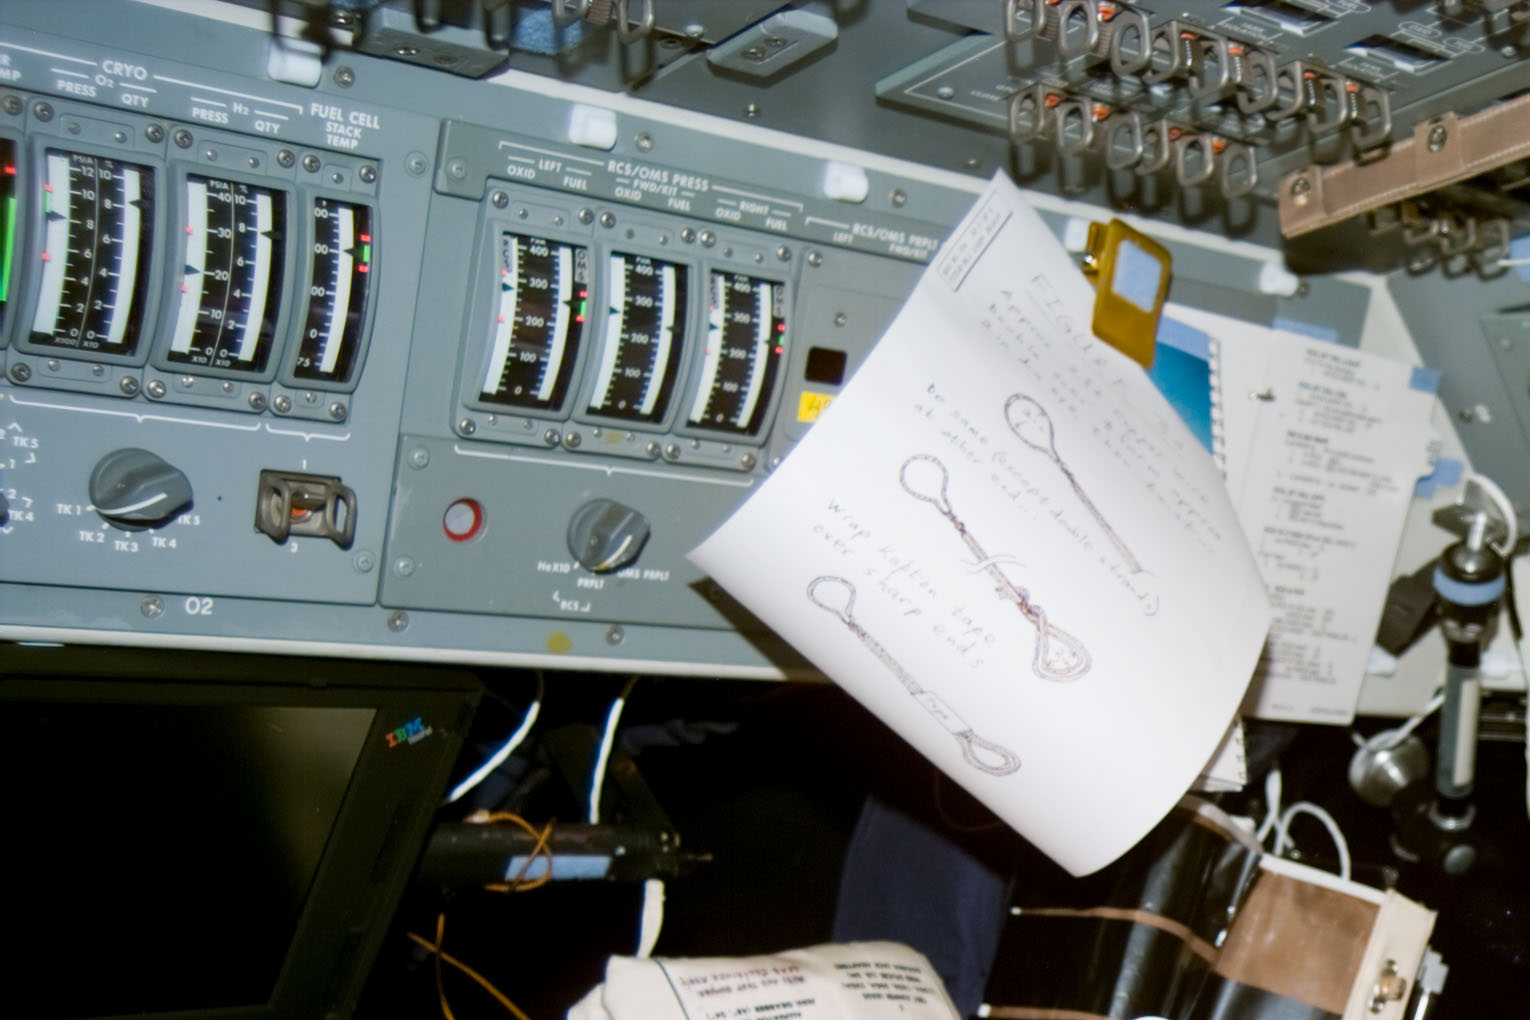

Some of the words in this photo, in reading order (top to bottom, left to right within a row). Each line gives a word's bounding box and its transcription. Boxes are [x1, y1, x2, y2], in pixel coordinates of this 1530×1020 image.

[102, 60, 148, 80] CRYO
[95, 75, 114, 88] O2
[56, 79, 97, 97] PRESS
[121, 93, 149, 108] QTY
[233, 102, 249, 116] H2
[191, 107, 229, 124] PRESS
[311, 103, 343, 122] FUEL
[349, 111, 380, 130] CELL
[254, 120, 280, 135] QTY
[326, 121, 362, 139] STACK
[327, 134, 358, 150] TEMP
[81, 166, 94, 177] 12
[538, 159, 562, 173] LEFT
[99, 168, 112, 180] 10
[507, 164, 536, 180] OXID
[608, 160, 669, 183] RCS/OMS
[672, 174, 710, 192] PRESS
[563, 176, 588, 191] FUEL
[632, 179, 678, 196] FWD/KIT
[82, 189, 95, 200] 10
[218, 192, 231, 202] 40
[234, 193, 246, 205] 10
[614, 187, 642, 202] OXID
[104, 198, 112, 208] 8
[668, 197, 691, 212] FUEL
[739, 200, 769, 216] RIGHT
[715, 208, 742, 221] OXID
[86, 220, 94, 229] 8
[238, 222, 246, 233] 8
[765, 217, 788, 232] FUEL
[103, 233, 111, 244] 6
[217, 228, 232, 239] 30
[84, 249, 92, 259] 6
[530, 246, 548, 256] 400
[236, 257, 244, 267] 6
[100, 268, 108, 278] 4
[214, 270, 228, 281] 20
[82, 277, 89, 286] 4
[529, 278, 548, 289] 300
[232, 289, 240, 299] 4
[76, 303, 84, 313] 2
[95, 300, 103, 310] 2
[211, 309, 222, 319] 10
[227, 320, 235, 330] 2
[526, 317, 544, 327] 200
[70, 328, 78, 337] 0
[87, 329, 95, 339] 0
[631, 334, 648, 344] 200
[205, 346, 213, 355] 0
[219, 349, 228, 358] 0
[520, 353, 536, 362] 100
[625, 368, 640, 377] 100
[385, 717, 425, 748] IBM
